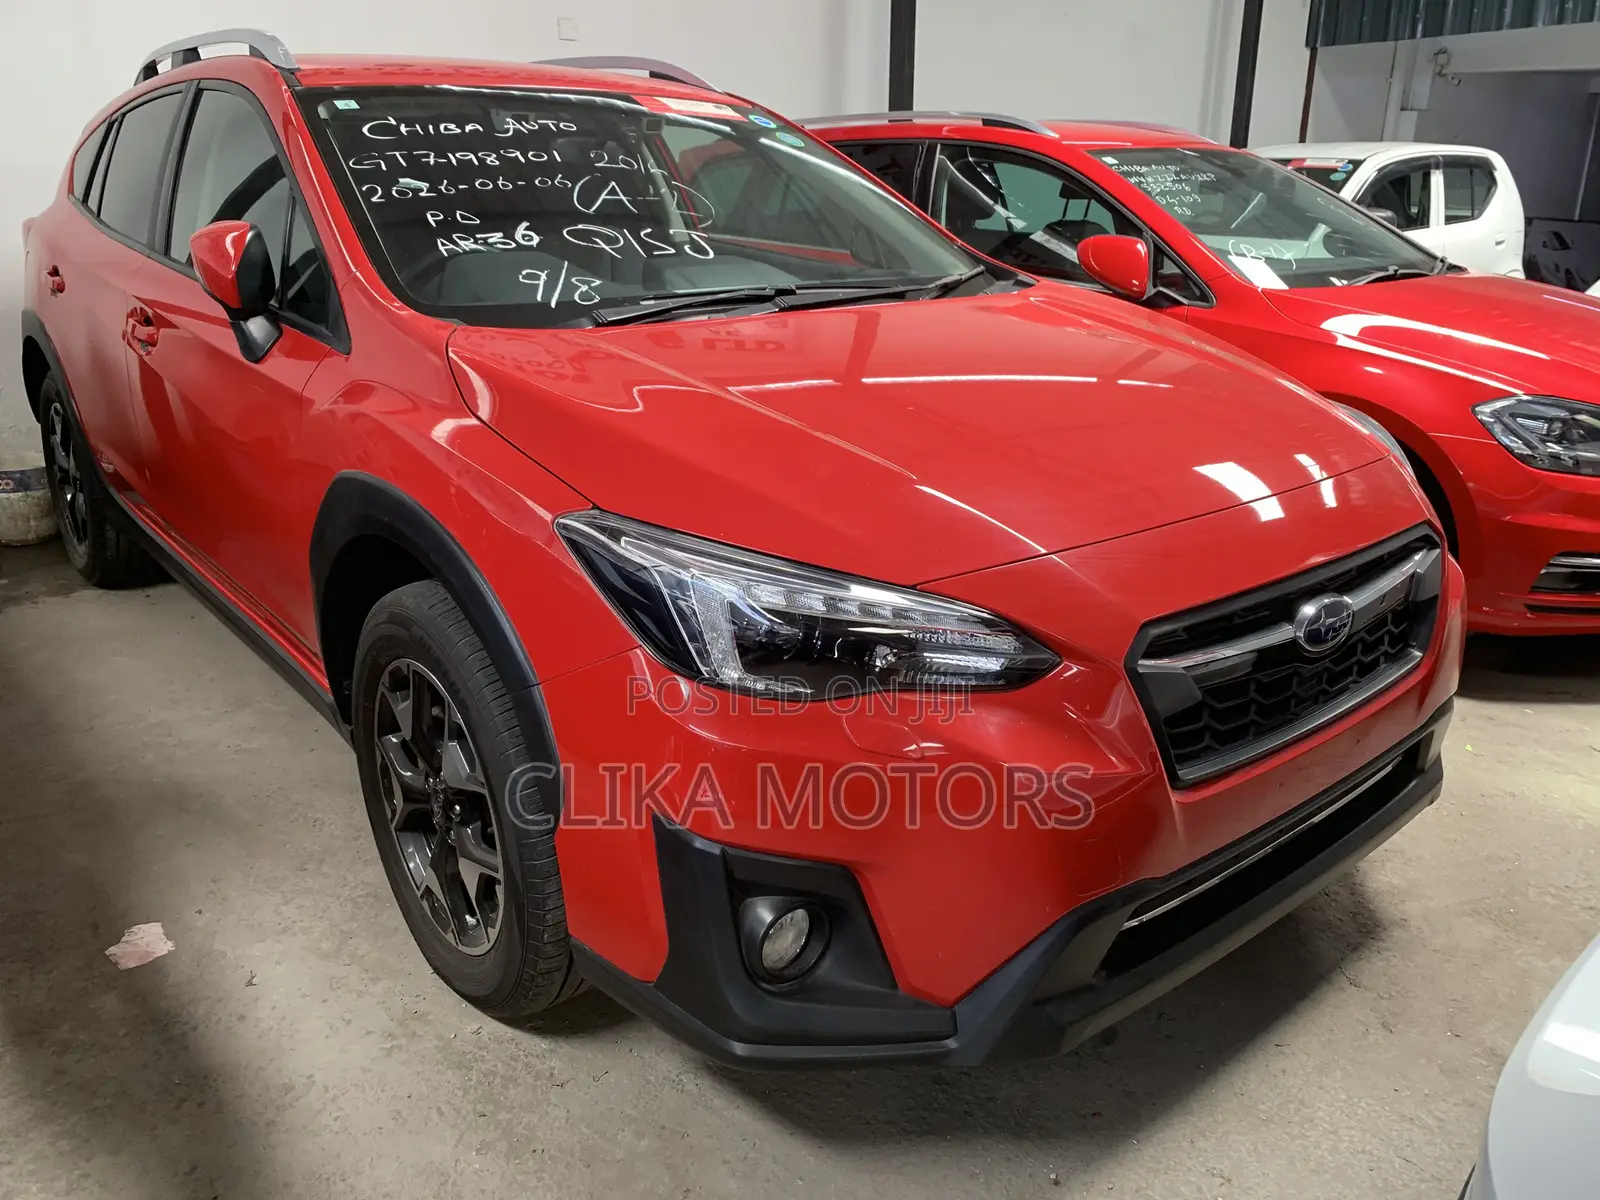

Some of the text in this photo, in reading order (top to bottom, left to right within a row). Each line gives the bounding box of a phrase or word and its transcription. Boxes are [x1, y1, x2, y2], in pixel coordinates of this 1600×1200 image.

[362, 116, 577, 139] CHIBA AUTO
[519, 261, 602, 308] 9/8
